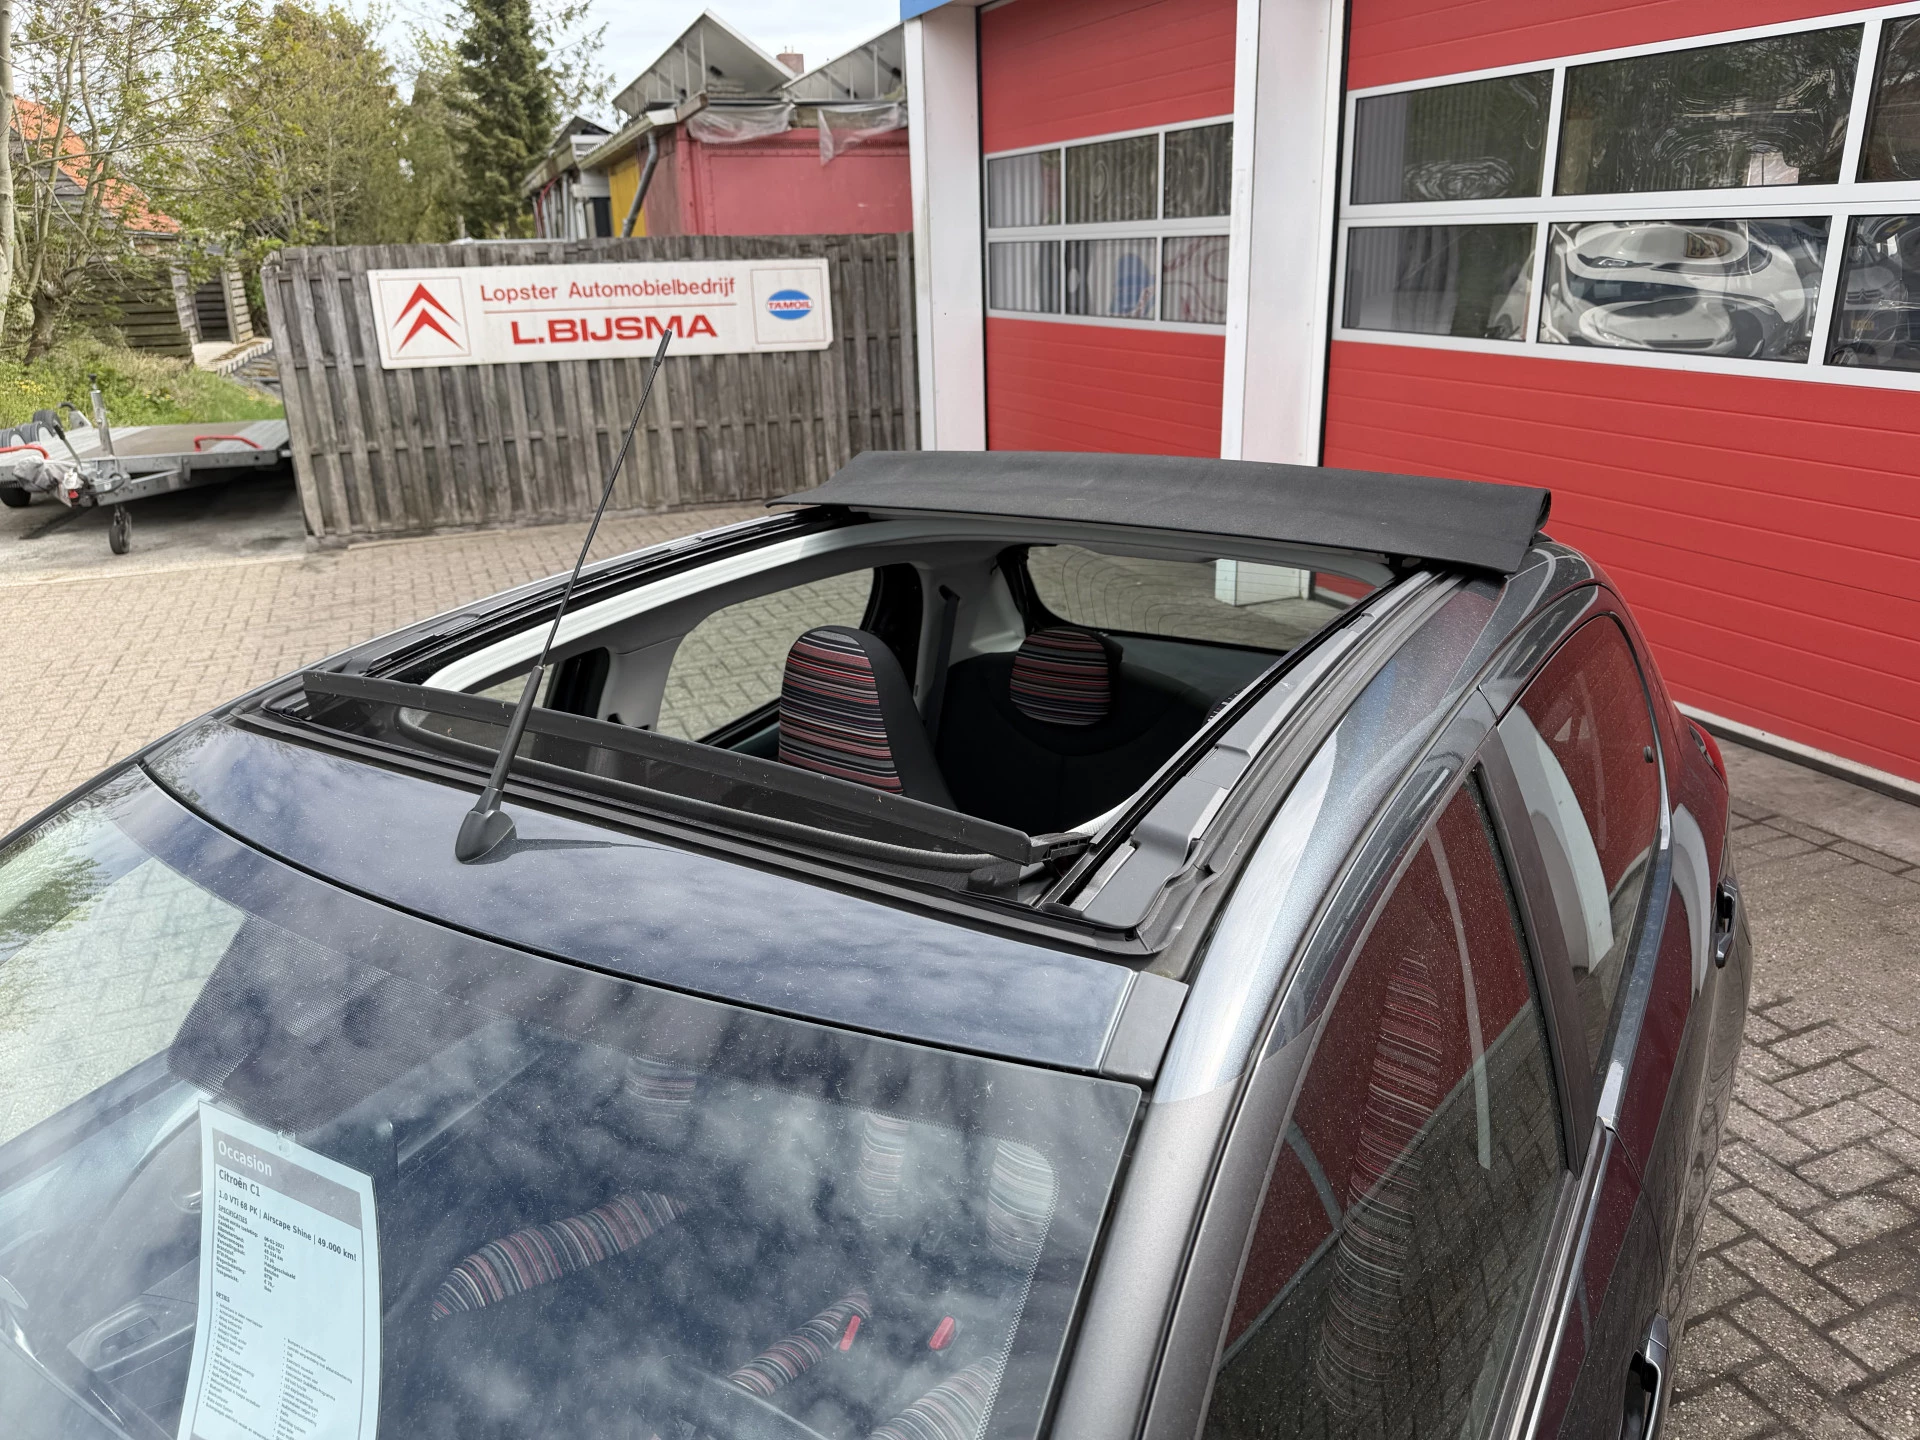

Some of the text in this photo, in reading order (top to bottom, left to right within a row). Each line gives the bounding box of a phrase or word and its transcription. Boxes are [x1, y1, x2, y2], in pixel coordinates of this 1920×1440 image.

[480, 277, 736, 304] Lopster Automobielbedrijf
[768, 301, 811, 310] TAMOIL
[511, 314, 718, 345] L.BIJSMA
[218, 1140, 272, 1177] Occasion
[218, 1169, 261, 1197] Citroën C1
[249, 1204, 258, 1215] PK
[263, 1212, 291, 1231] Airscape
[292, 1225, 312, 1241] Shine
[317, 1237, 342, 1254] 49.000
[343, 1248, 357, 1261] km!
